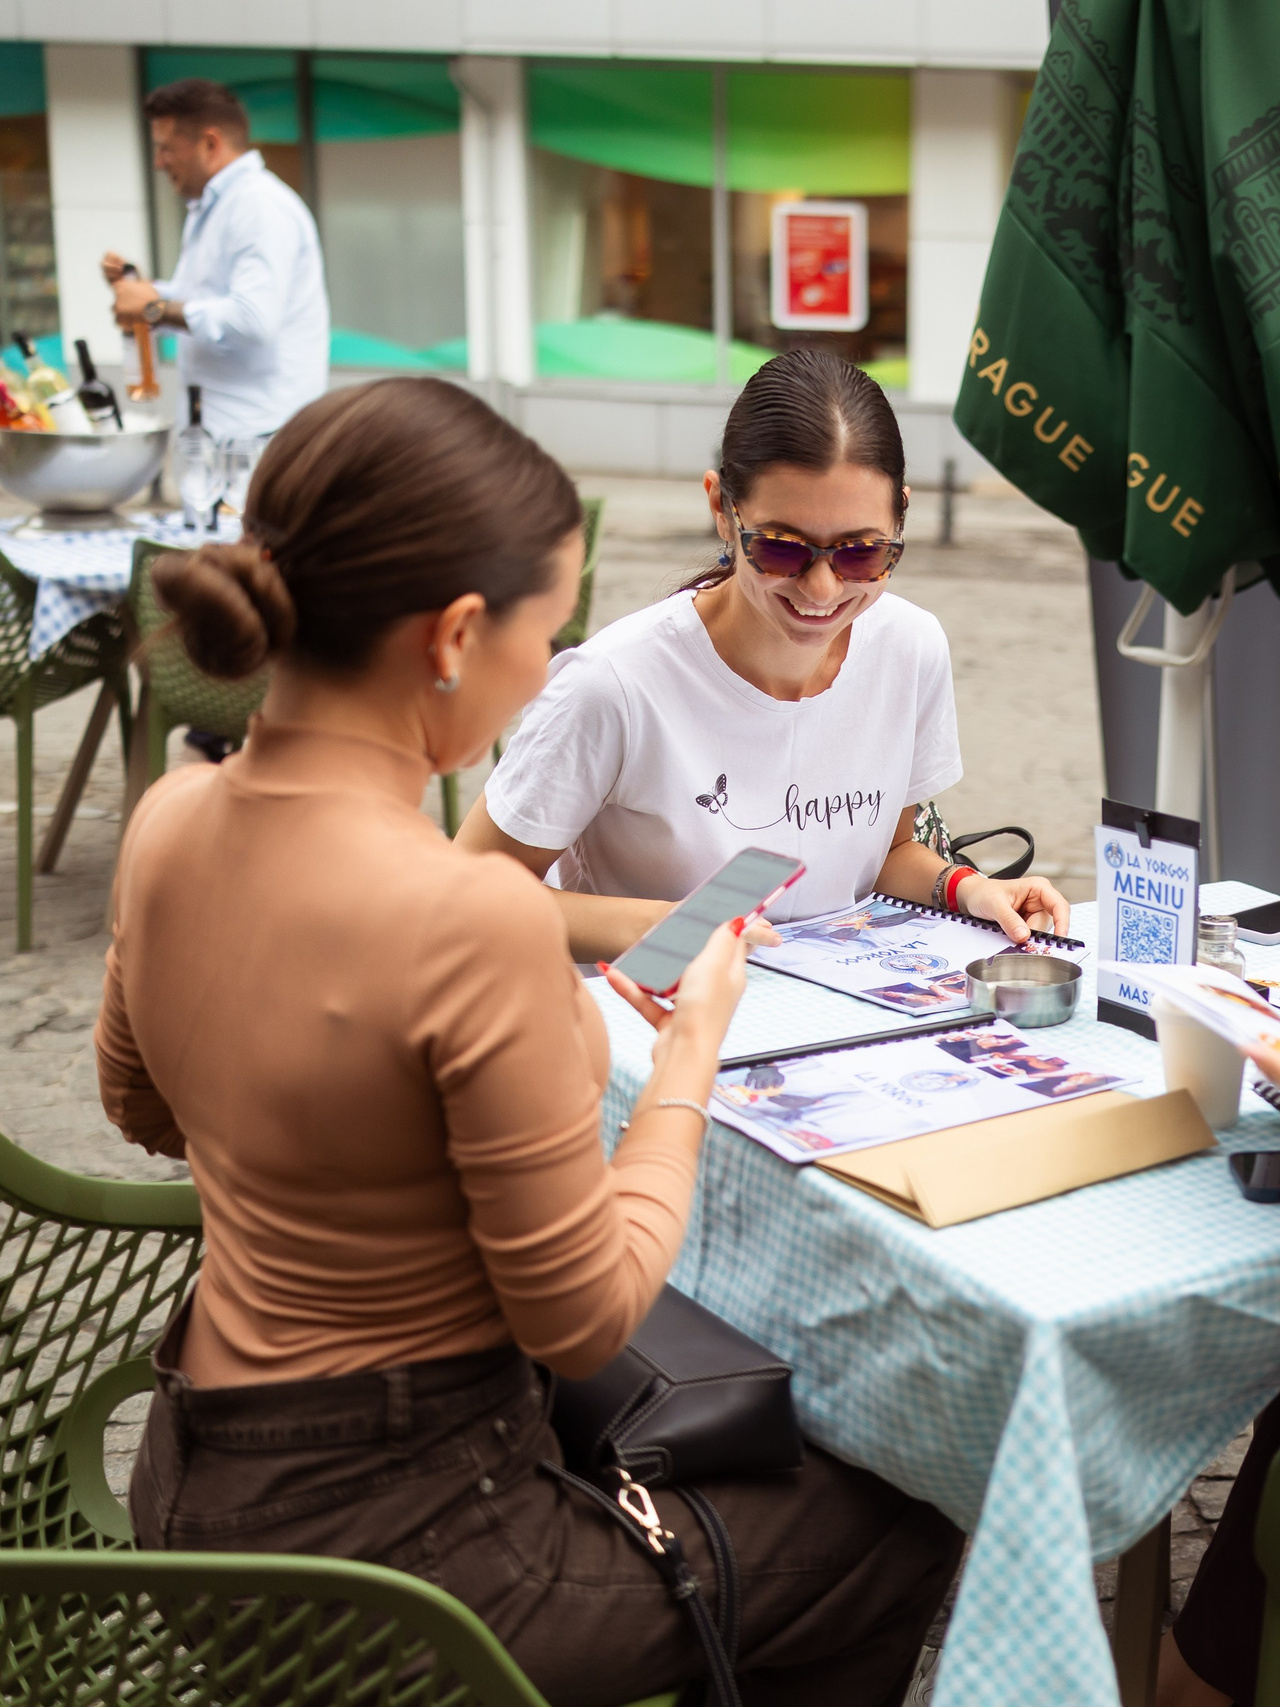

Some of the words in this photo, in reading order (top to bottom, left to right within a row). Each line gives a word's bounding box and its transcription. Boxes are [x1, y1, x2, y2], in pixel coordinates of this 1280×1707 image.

[968, 318, 1095, 473] RAGUE
[785, 783, 886, 831] happy
[1126, 852, 1141, 869] LA
[1145, 856, 1190, 882] YORGOS
[1113, 869, 1184, 910] MENIU
[1118, 982, 1154, 1007] MAS
